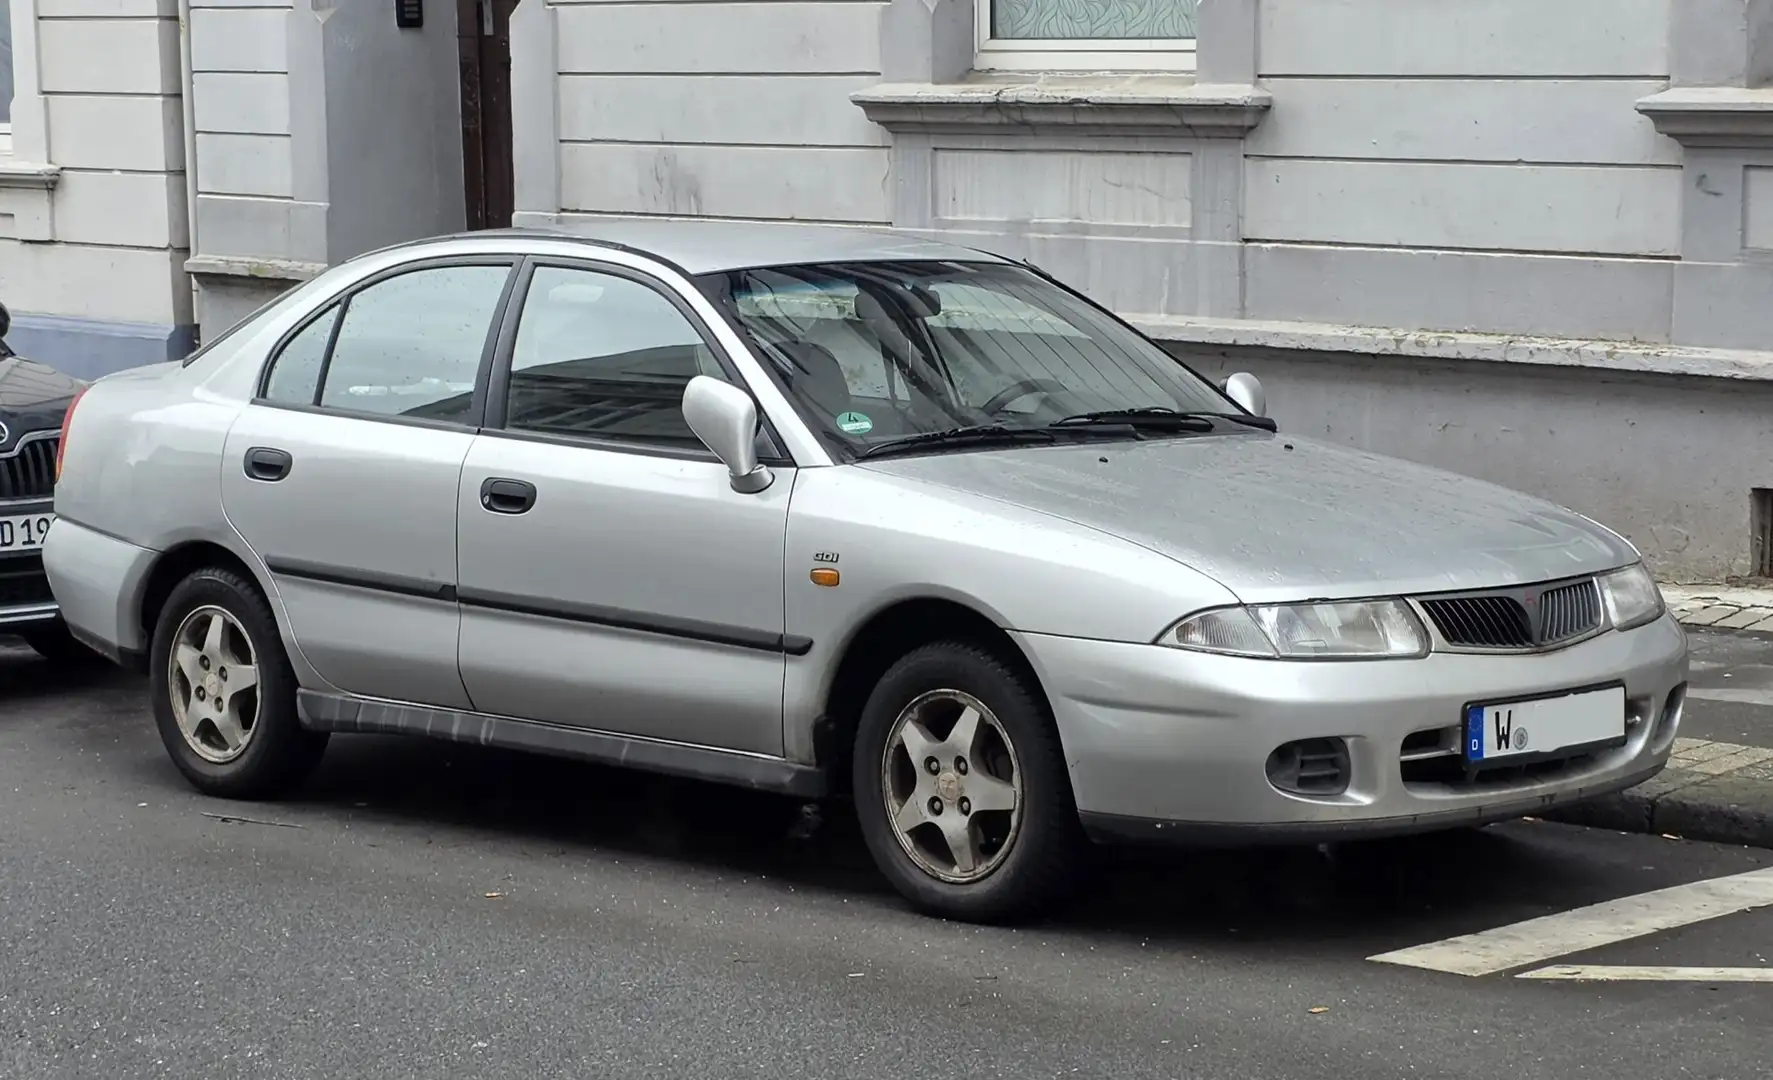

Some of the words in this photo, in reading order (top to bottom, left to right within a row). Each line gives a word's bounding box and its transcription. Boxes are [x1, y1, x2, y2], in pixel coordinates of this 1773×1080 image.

[848, 412, 859, 422] 4
[20, 517, 57, 546] 19
[813, 552, 840, 563] GDI
[1495, 709, 1512, 751] W
[1471, 739, 1479, 751] D
